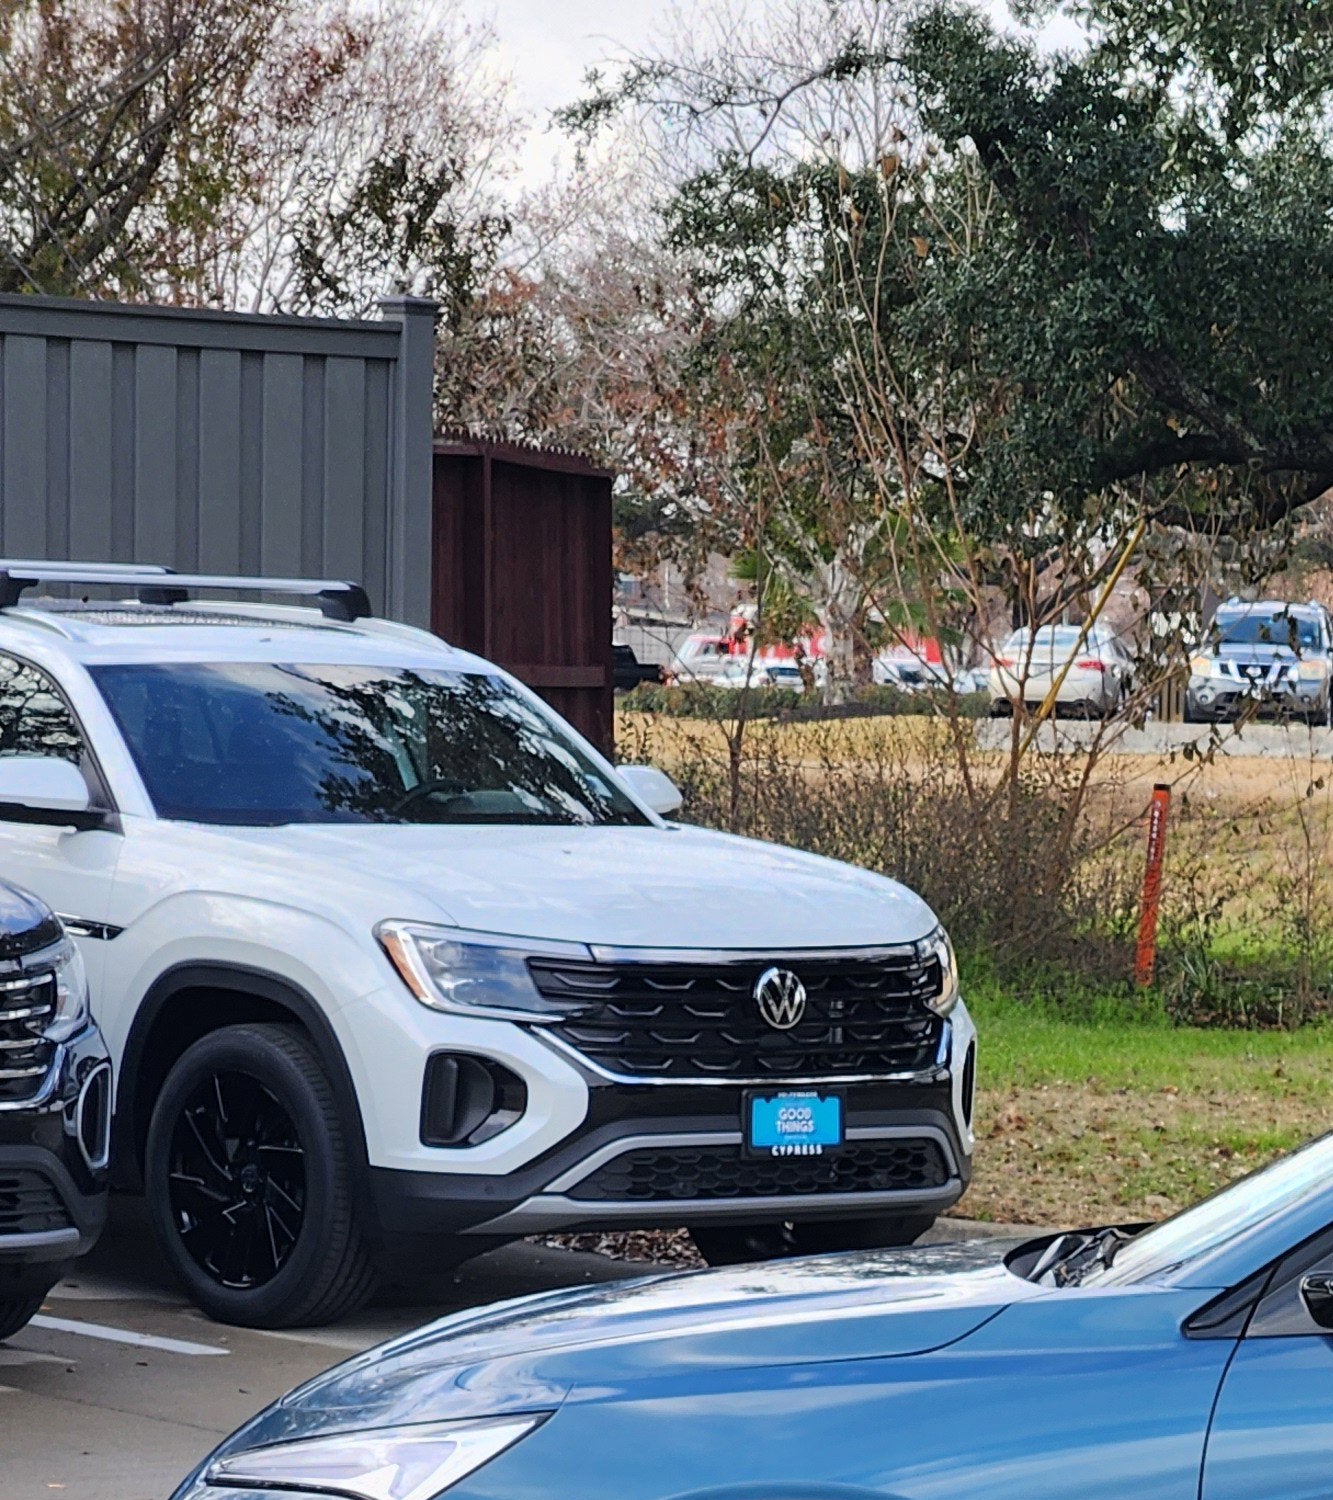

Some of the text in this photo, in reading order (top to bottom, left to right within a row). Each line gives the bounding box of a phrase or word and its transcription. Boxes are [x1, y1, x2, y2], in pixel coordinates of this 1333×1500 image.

[778, 1107, 812, 1120] GOOD
[775, 1120, 815, 1133] THINGS
[771, 1144, 823, 1156] CYPRESS
